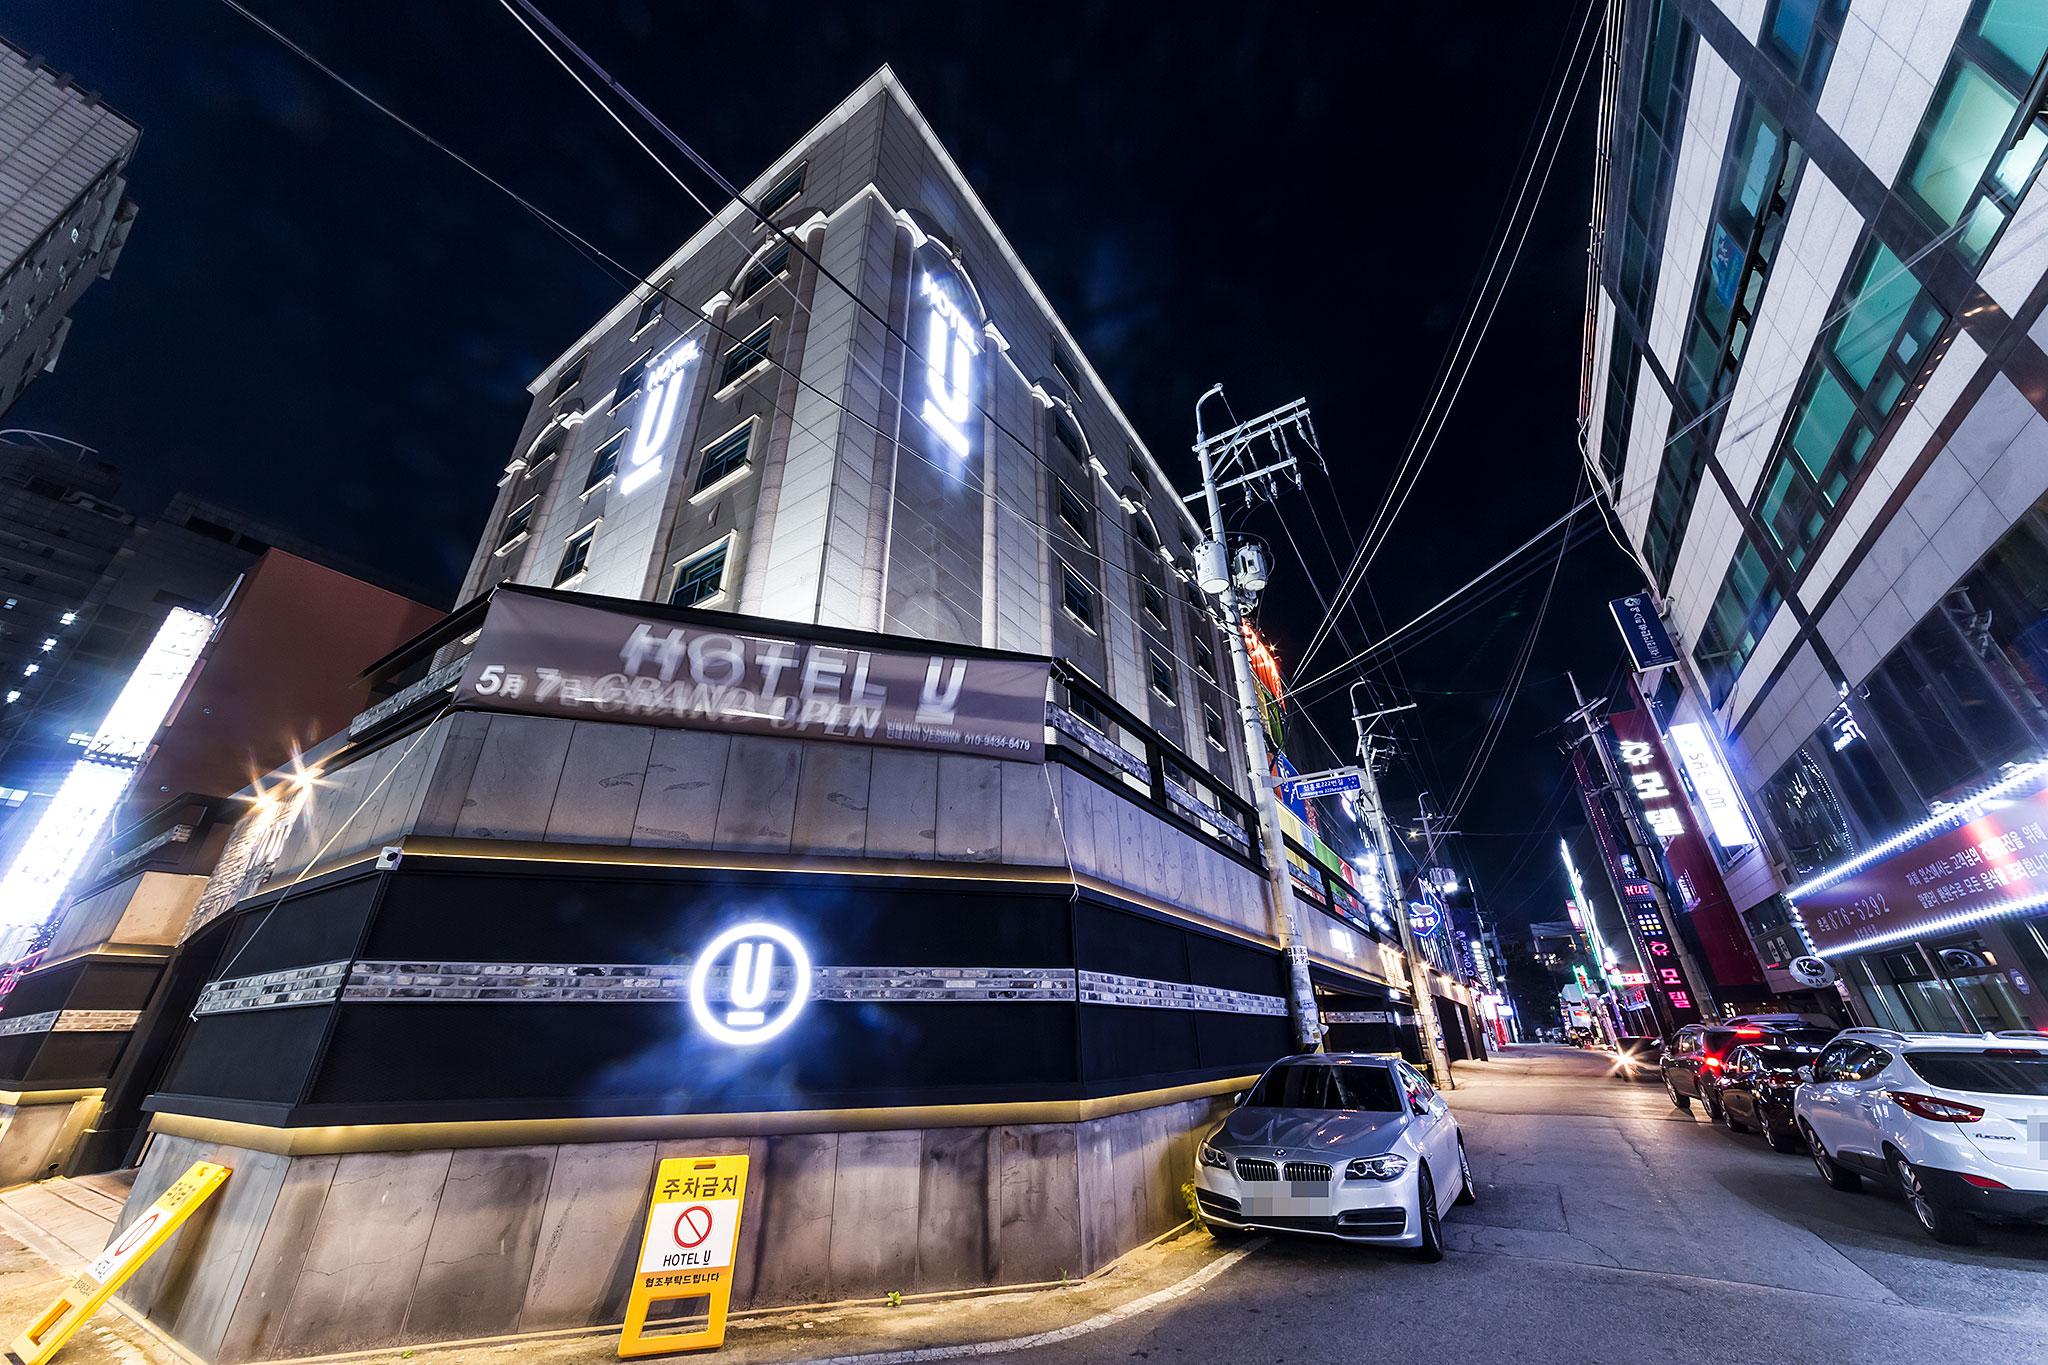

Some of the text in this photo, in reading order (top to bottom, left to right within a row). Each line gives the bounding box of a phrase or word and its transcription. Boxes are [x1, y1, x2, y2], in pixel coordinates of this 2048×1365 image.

[620, 623, 968, 725] HOTEL U
[592, 672, 757, 723] GRAND
[769, 695, 883, 738] OPEN
[1949, 846, 1983, 870] 고객님의
[1624, 884, 1650, 897] HUE
[1963, 875, 1984, 894] 모든
[1827, 893, 1891, 931] 876-5292
[662, 1174, 738, 1200] 주차금지
[662, 1249, 712, 1267] HOTEL U
[645, 1272, 720, 1288] 협조부탁드립니다
